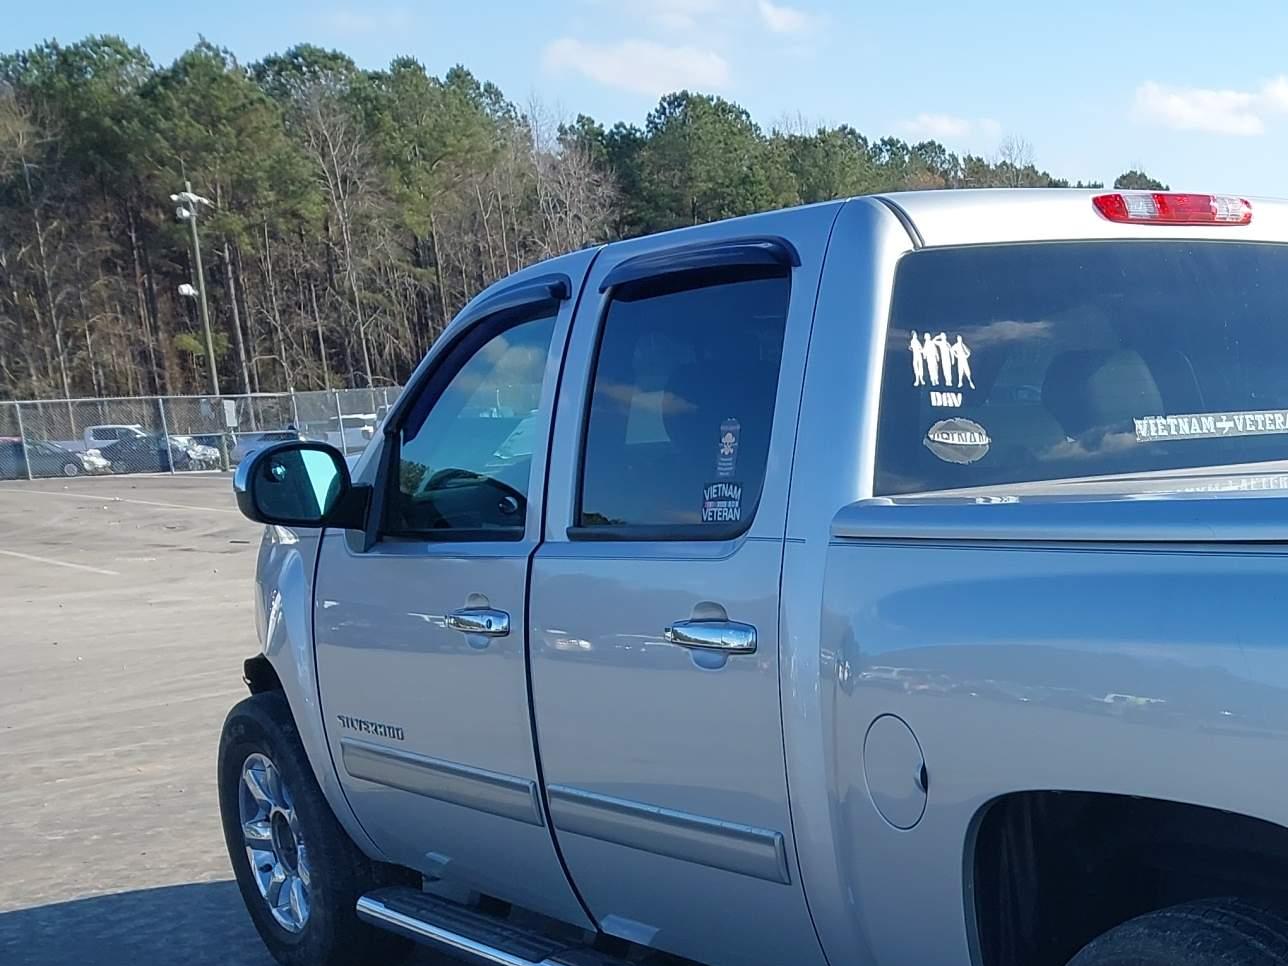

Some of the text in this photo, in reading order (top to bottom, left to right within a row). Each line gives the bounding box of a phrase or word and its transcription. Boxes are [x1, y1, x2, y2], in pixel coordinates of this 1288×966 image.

[1135, 415, 1215, 438] VIETNAM
[703, 483, 741, 500] VIETNAM
[702, 507, 741, 521] VETERAN
